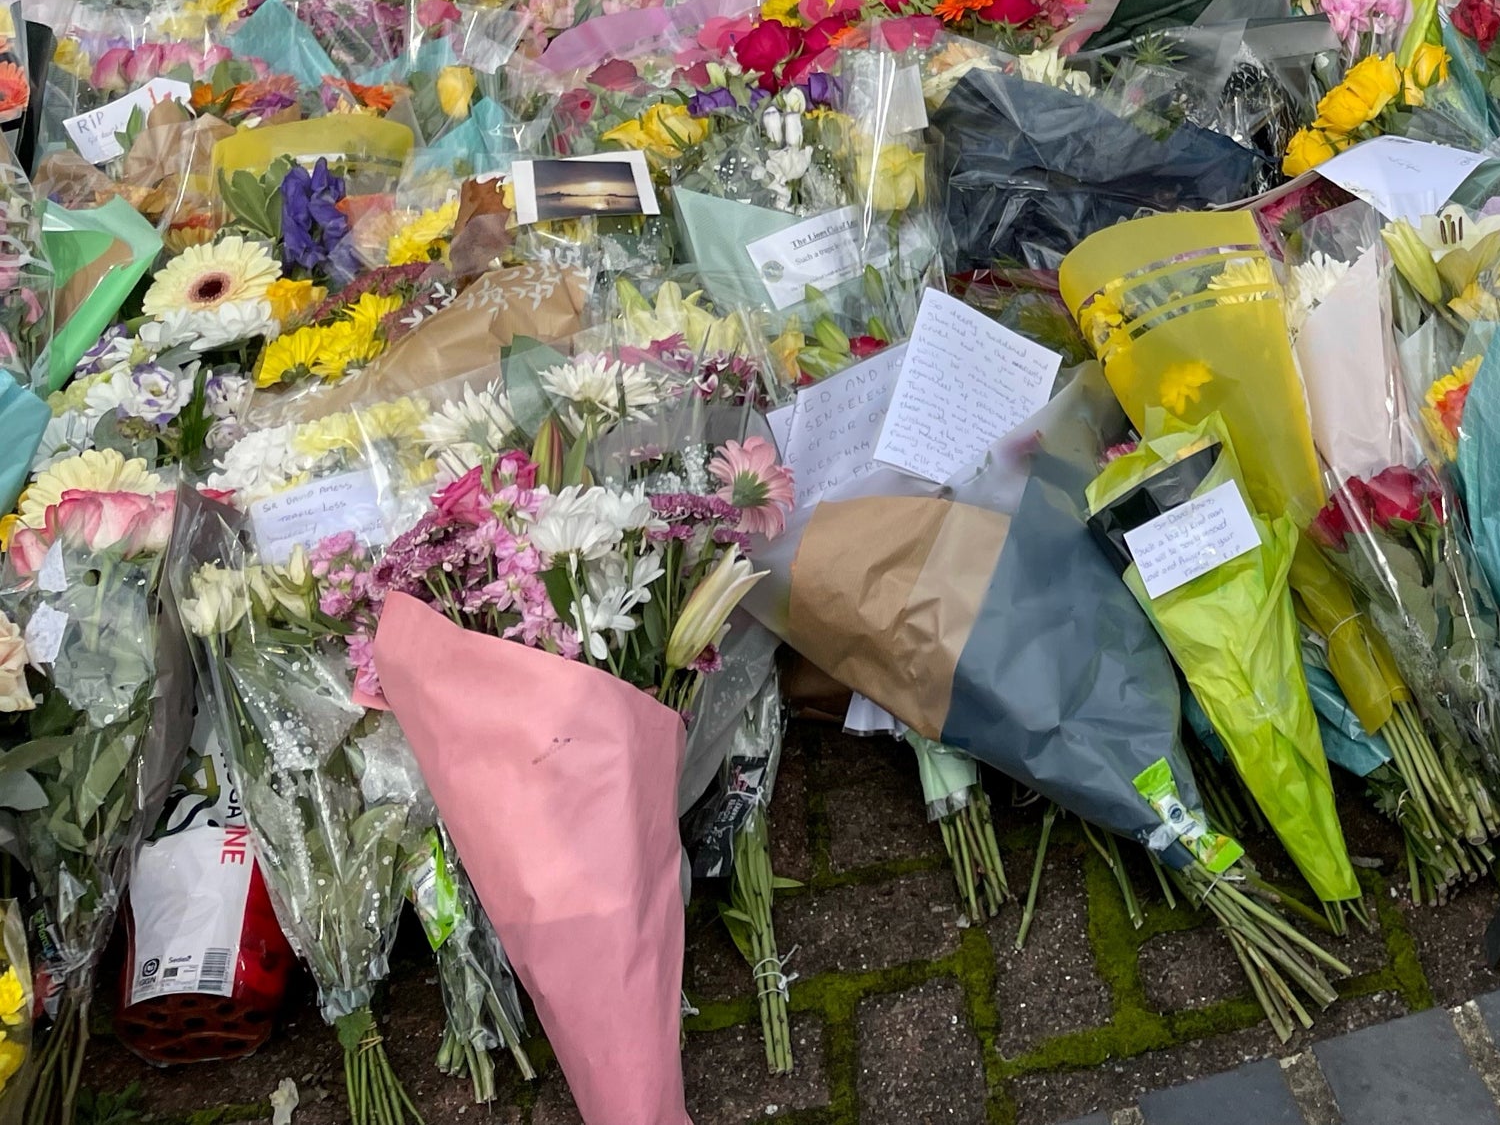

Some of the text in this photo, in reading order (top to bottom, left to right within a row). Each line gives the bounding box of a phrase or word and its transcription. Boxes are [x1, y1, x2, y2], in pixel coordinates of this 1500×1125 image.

[791, 238, 808, 249] The
[794, 253, 813, 264] Such
[845, 369, 877, 391] AND
[805, 385, 886, 431] SENSELESS
[826, 420, 856, 440] OUR
